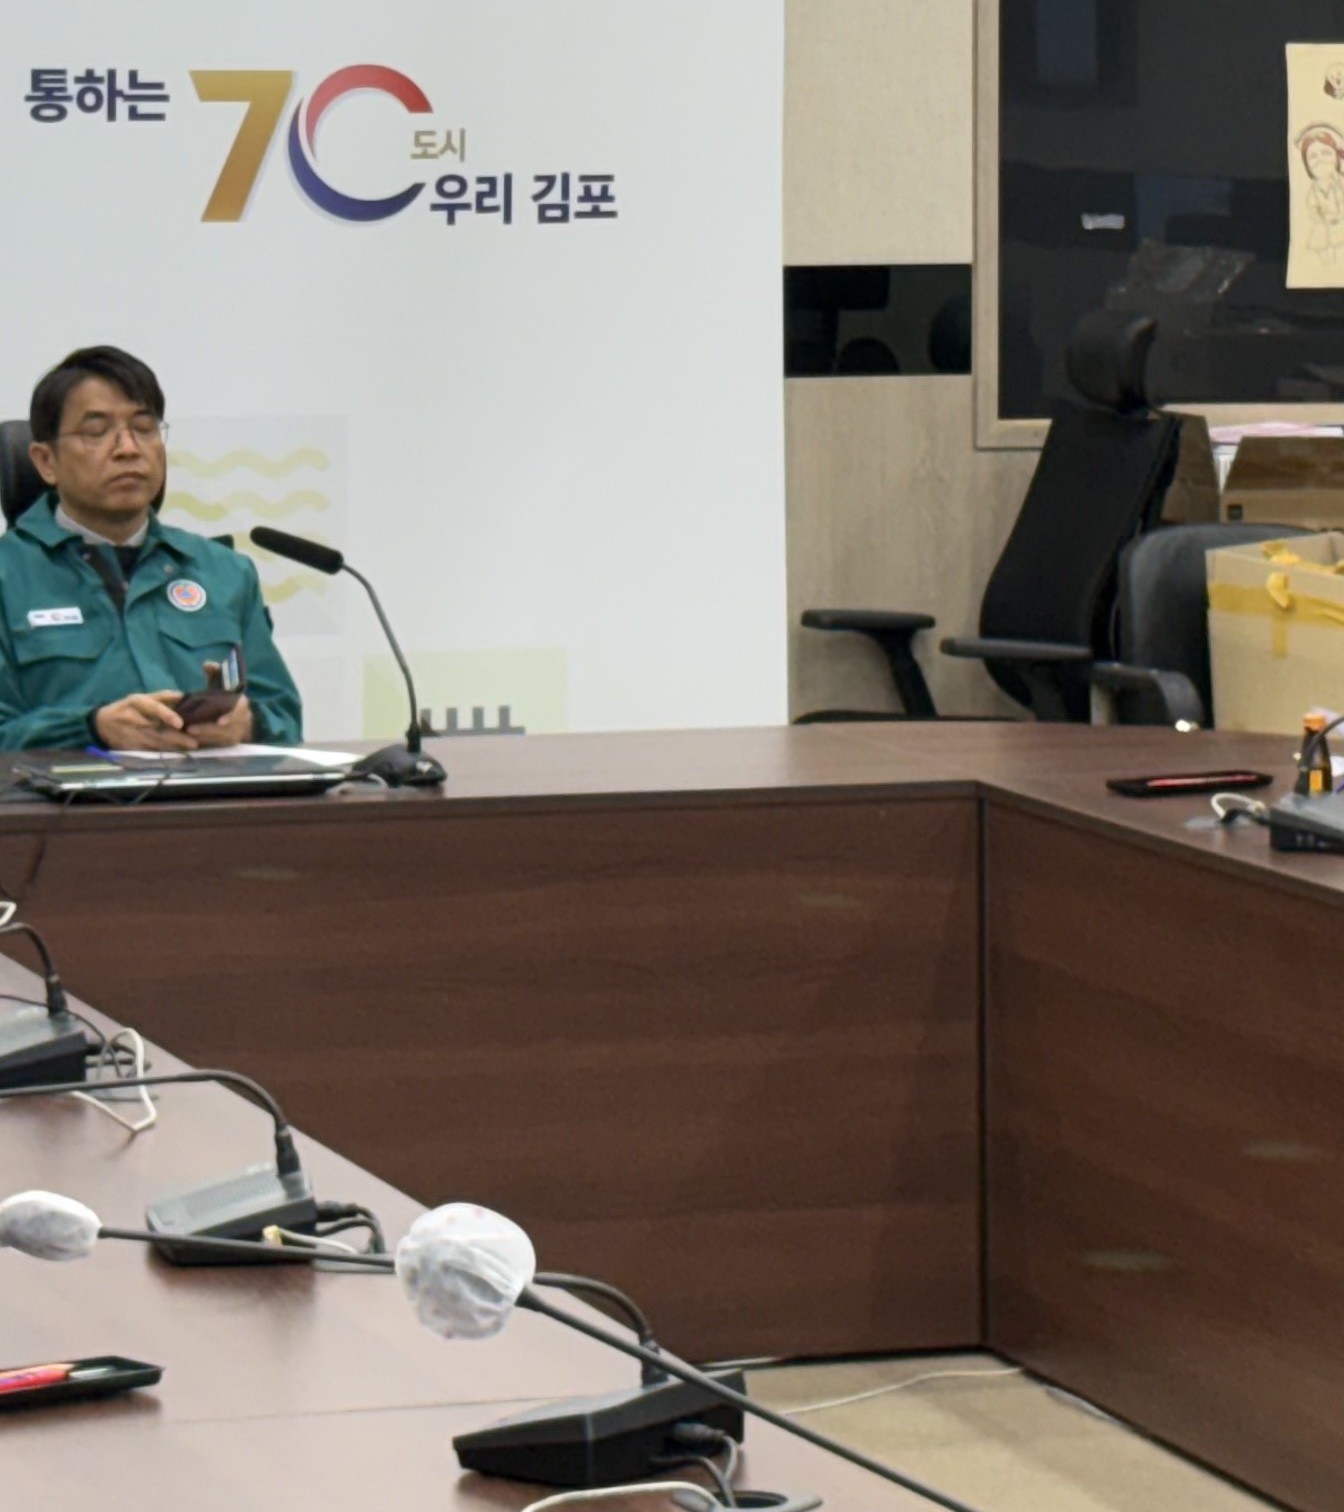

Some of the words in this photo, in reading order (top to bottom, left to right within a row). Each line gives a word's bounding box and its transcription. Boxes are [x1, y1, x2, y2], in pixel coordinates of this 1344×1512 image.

[24, 68, 170, 123] 통하는
[410, 128, 466, 163] 도시
[429, 172, 514, 226] 우리
[530, 172, 619, 226] 김포
